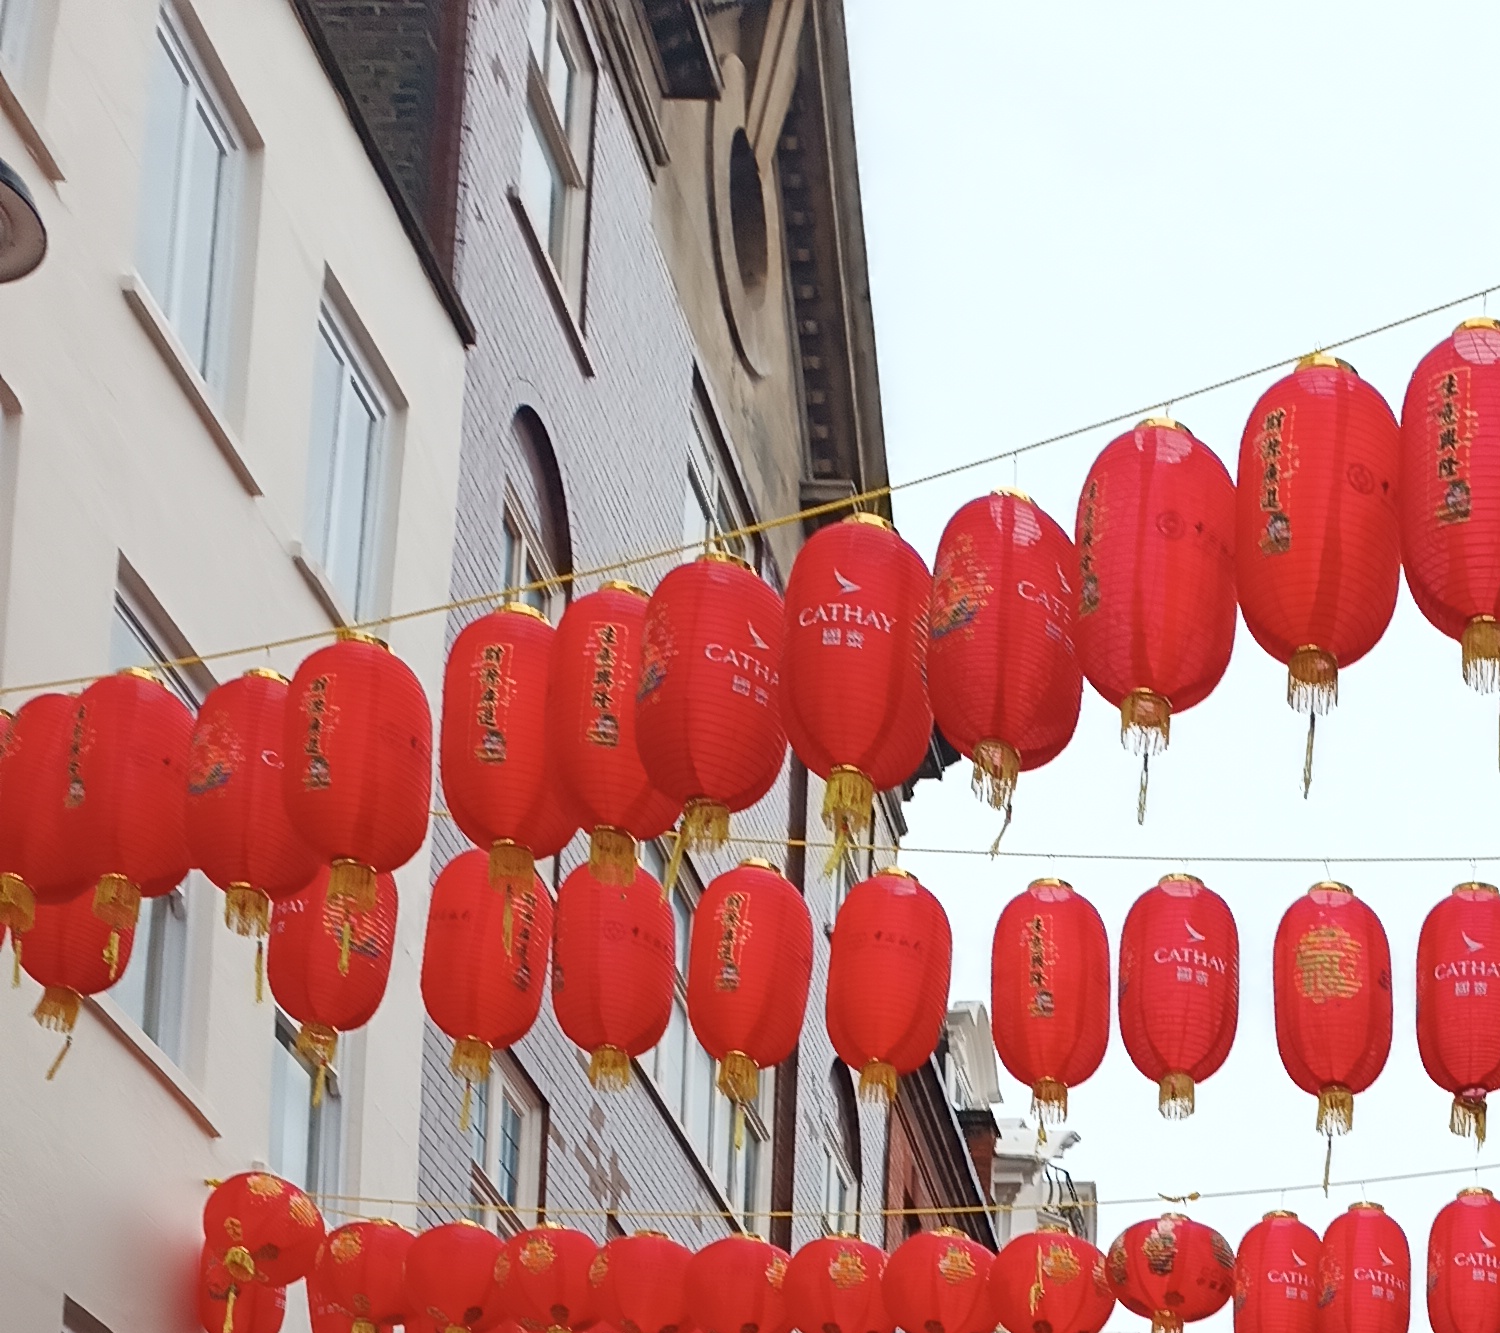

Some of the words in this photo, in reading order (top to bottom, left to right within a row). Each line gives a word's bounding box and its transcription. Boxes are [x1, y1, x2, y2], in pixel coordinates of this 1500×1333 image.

[799, 603, 897, 634] CATHAY
[705, 643, 779, 686] CATHA
[1154, 947, 1227, 976] CATHAY
